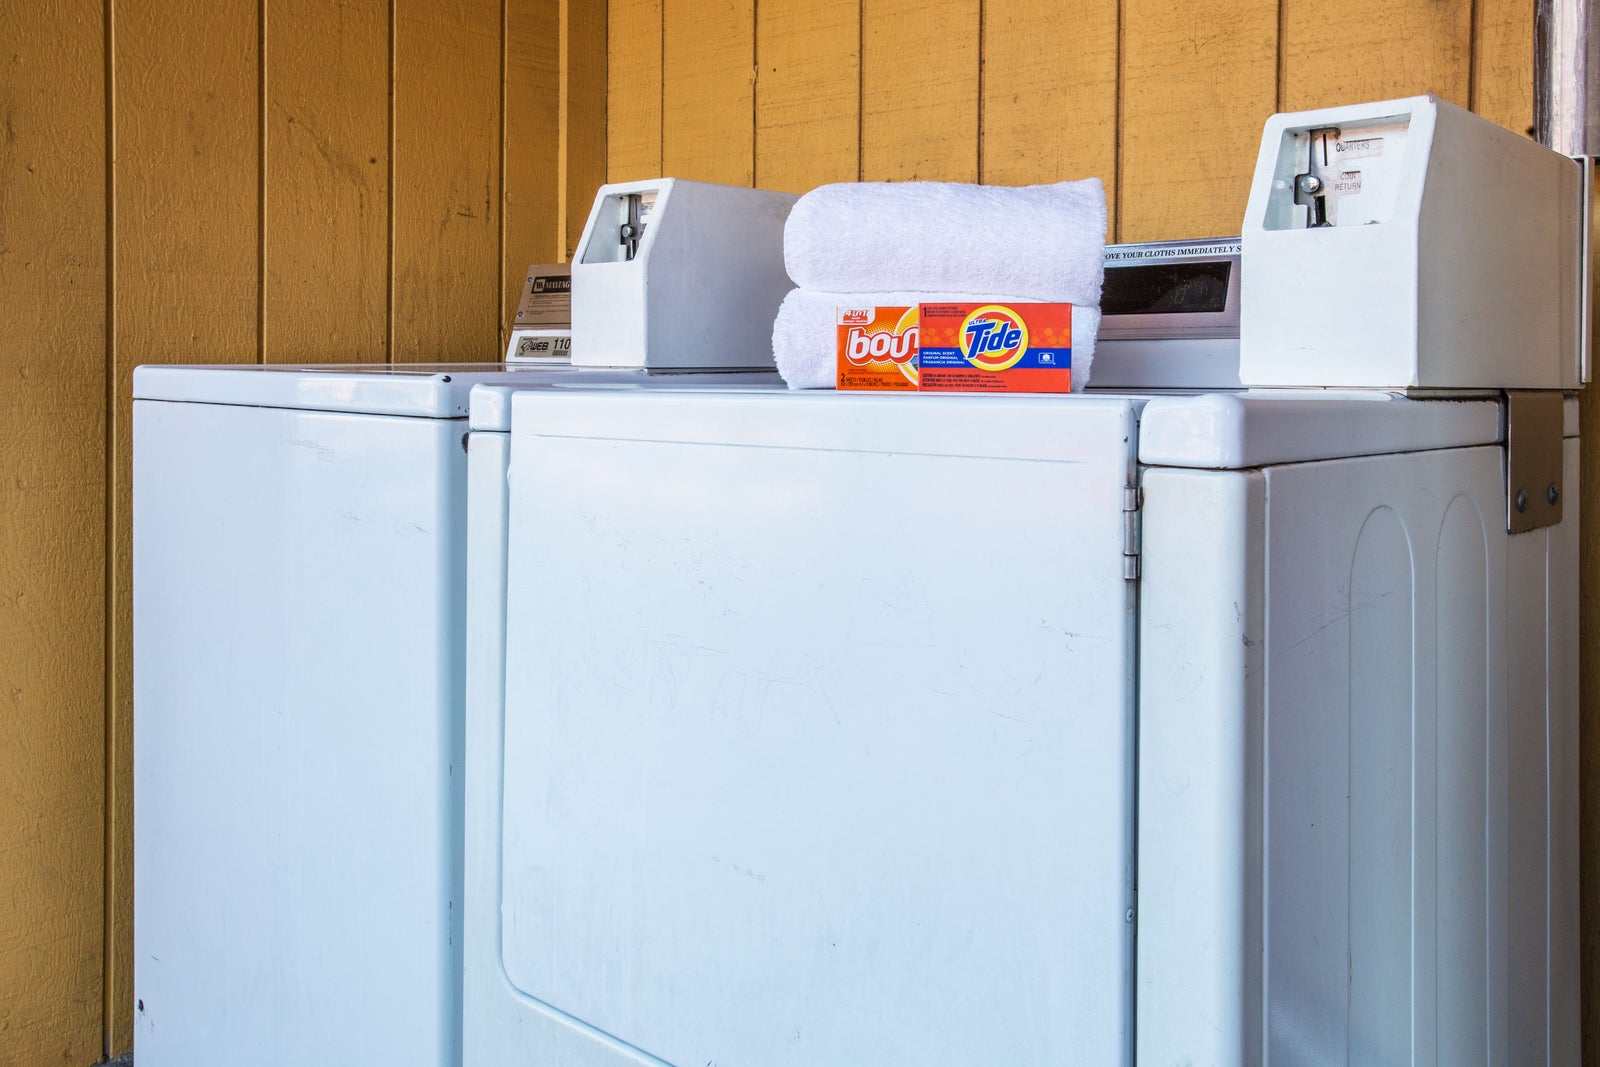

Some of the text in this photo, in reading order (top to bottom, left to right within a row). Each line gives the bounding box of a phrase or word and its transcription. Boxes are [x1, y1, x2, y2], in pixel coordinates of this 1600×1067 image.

[1336, 141, 1370, 152] QUARTERS
[1335, 183, 1361, 191] RETURN
[1122, 251, 1143, 259] YOUR
[1145, 248, 1176, 257] CLOTHS
[1177, 245, 1234, 256] IMMEDIATELY
[545, 281, 570, 289] MAYTAG
[553, 338, 571, 350] 110
[966, 322, 1022, 359] Tide
